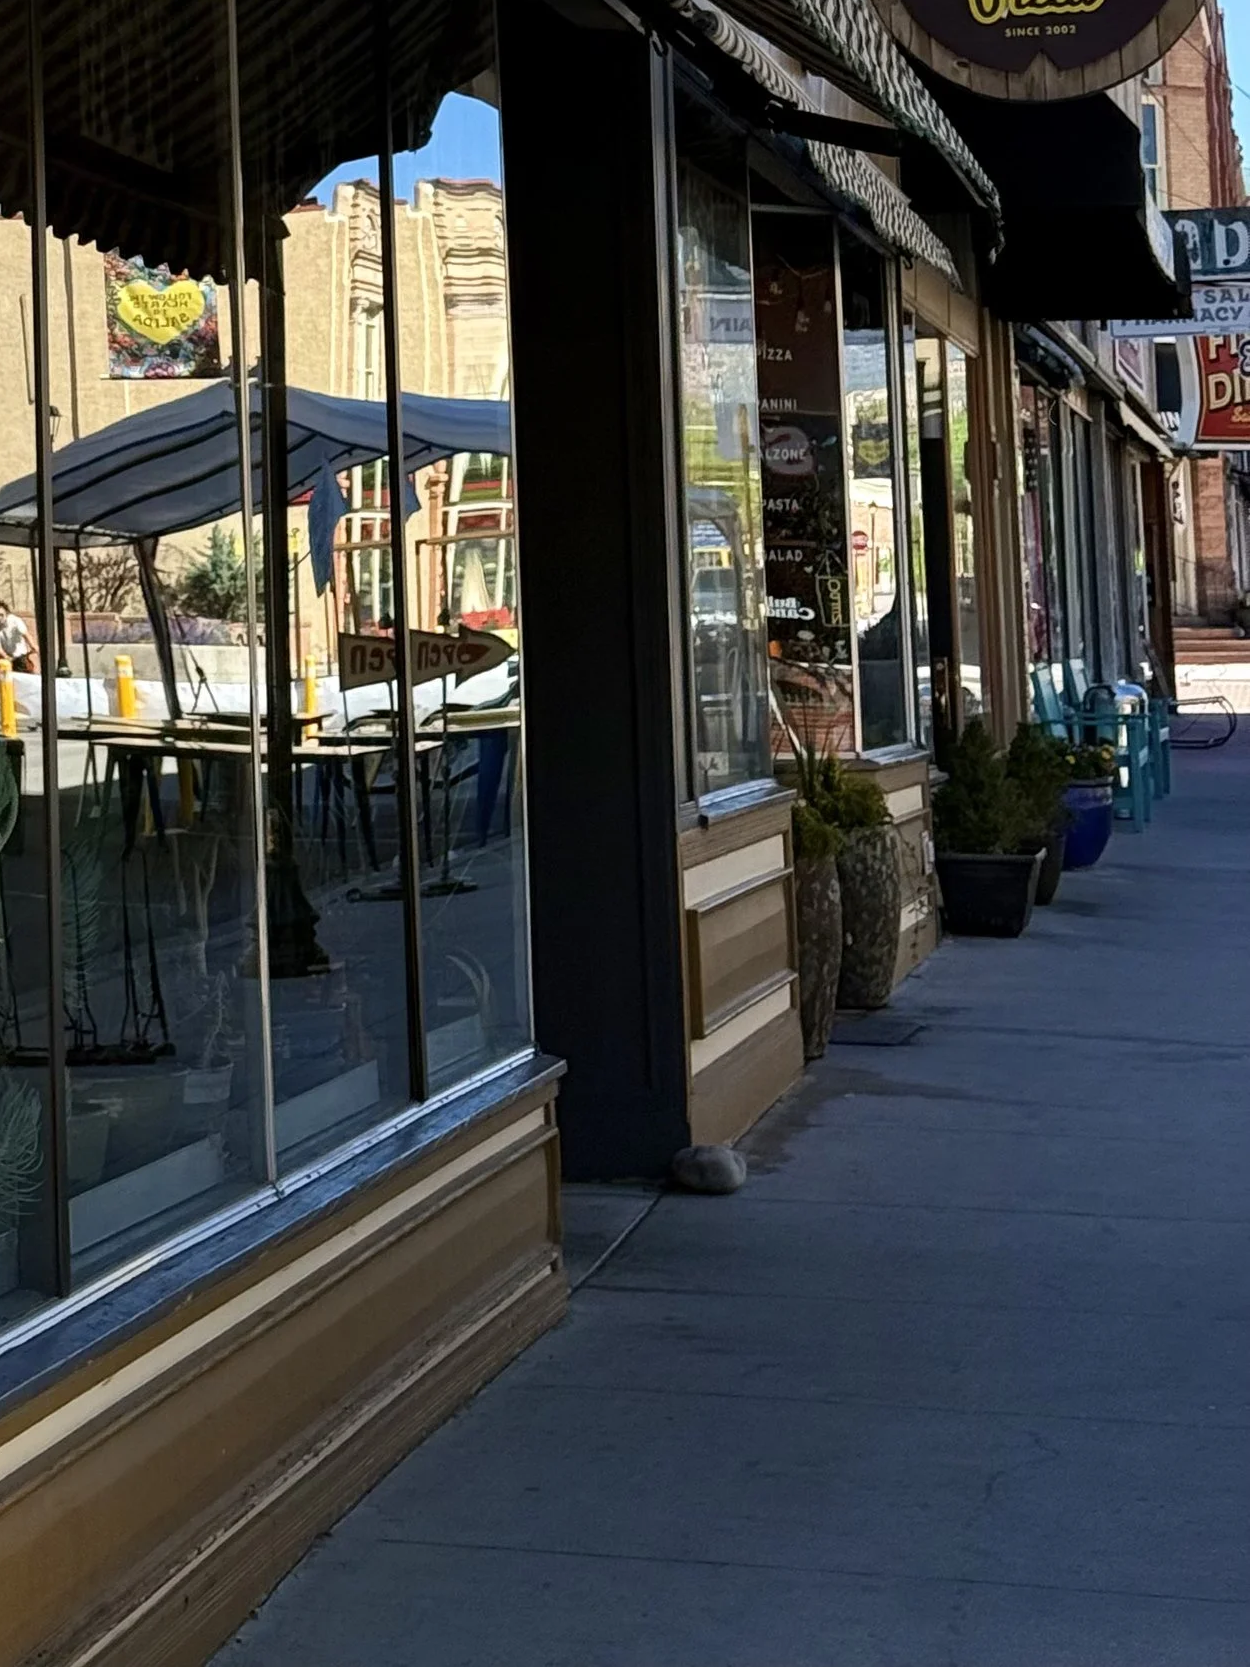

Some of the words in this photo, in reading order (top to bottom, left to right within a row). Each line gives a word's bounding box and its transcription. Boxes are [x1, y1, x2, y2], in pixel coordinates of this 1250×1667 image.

[1005, 26, 1040, 37] SINCE
[1046, 25, 1076, 35] 2002
[758, 398, 798, 411] ANINI
